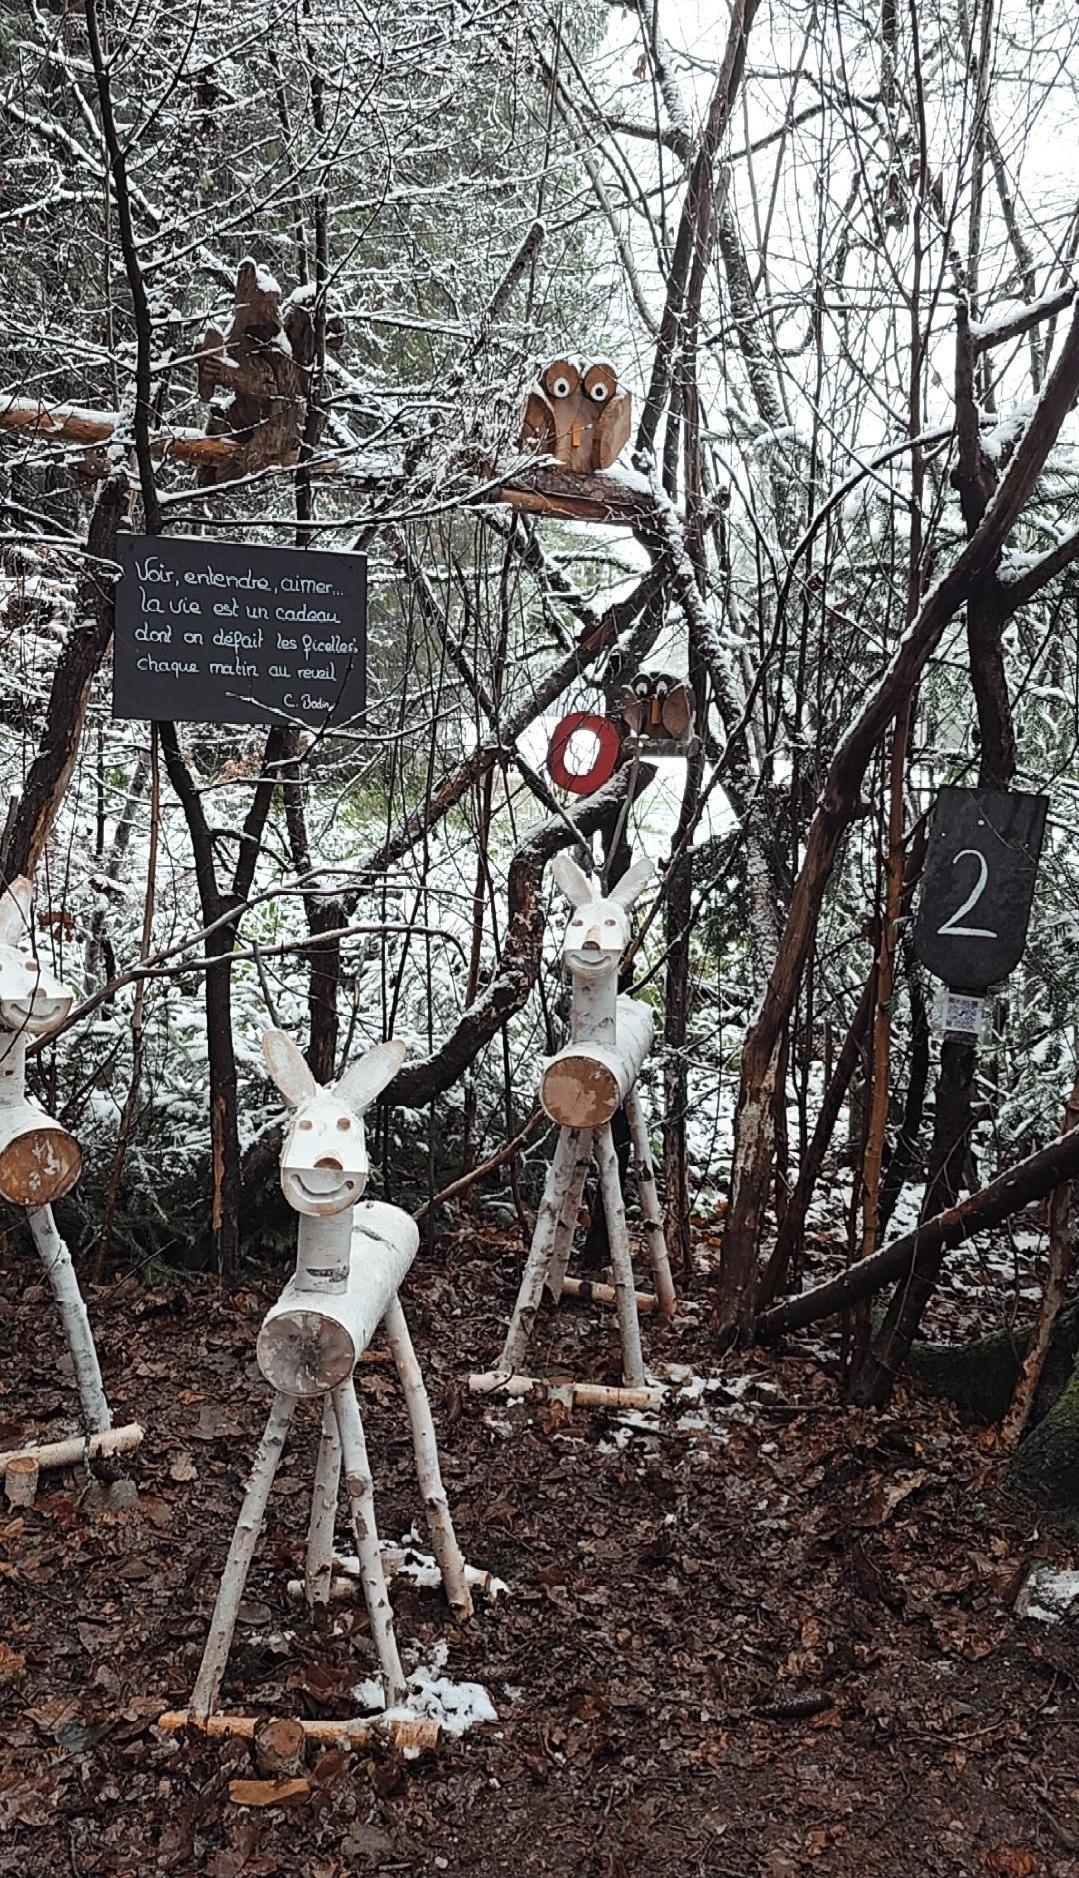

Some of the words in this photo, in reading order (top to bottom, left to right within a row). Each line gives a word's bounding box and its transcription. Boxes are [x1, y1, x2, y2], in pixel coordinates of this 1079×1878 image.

[134, 556, 179, 587] Voir,
[183, 565, 278, 595] entendre,
[169, 597, 202, 615] vie
[212, 597, 240, 618] est
[245, 605, 270, 620] un
[275, 603, 342, 624] cadeau
[134, 621, 172, 643] dont
[183, 632, 204, 645] on
[212, 627, 264, 655] défait
[276, 632, 298, 650] les
[136, 652, 200, 679] chaque
[209, 655, 259, 678] matin
[268, 664, 291, 678] au
[283, 693, 299, 708] C.
[936, 849, 998, 939] 2
